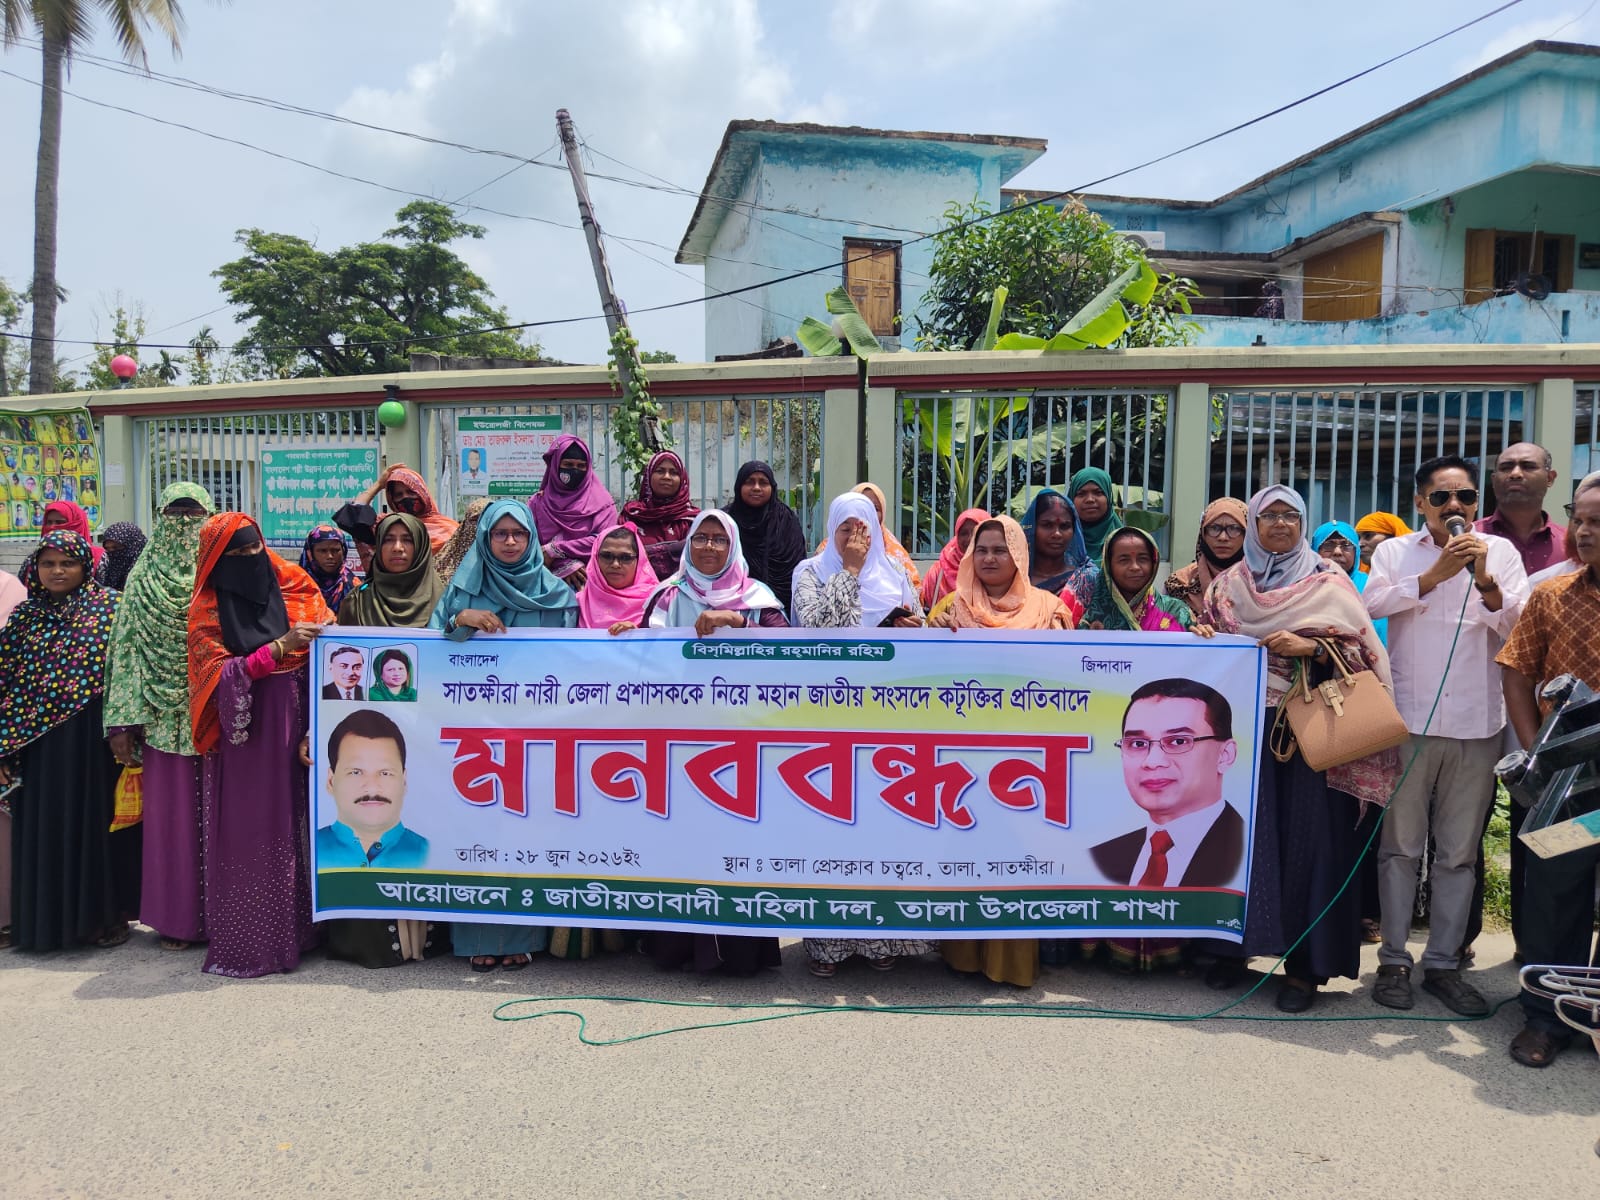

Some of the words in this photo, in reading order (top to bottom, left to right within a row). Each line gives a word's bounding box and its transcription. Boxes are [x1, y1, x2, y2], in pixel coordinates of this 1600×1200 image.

[448, 654, 499, 667] বাংলাদেশ
[847, 644, 886, 657] রহিম
[1081, 656, 1132, 672] জিন্দাবাদ
[443, 675, 520, 704] সাতক্ষীরা
[524, 675, 561, 704] নারী
[567, 682, 611, 704] জেলা
[616, 682, 705, 705] প্রশাসককে
[710, 676, 751, 705] নিয়ে
[756, 682, 802, 706] মহান
[807, 677, 866, 707] জাতীয়
[871, 686, 932, 710] সংসদে
[937, 680, 1004, 717] কটূক্তির
[1011, 681, 1091, 712] প্রতিবাদে
[441, 727, 1092, 827] মানববন্ধন
[456, 844, 499, 862] তারিখ
[516, 850, 538, 864] ২৮
[546, 851, 571, 866] জুন
[578, 847, 640, 866] ২০২৬ইং
[723, 857, 750, 873] স্থান
[769, 859, 806, 873] তালা
[813, 859, 873, 876] প্রেসক্লাব
[987, 855, 1053, 875] সাতক্ষীরা
[376, 881, 511, 906] আয়োজনে
[541, 881, 724, 917] জাতীয়তাবাদী
[731, 892, 819, 921] মহিলা
[826, 900, 883, 924] দল,
[895, 899, 970, 922] তালা
[976, 895, 1102, 920] উপজেলা
[1109, 898, 1180, 920] শাখা
